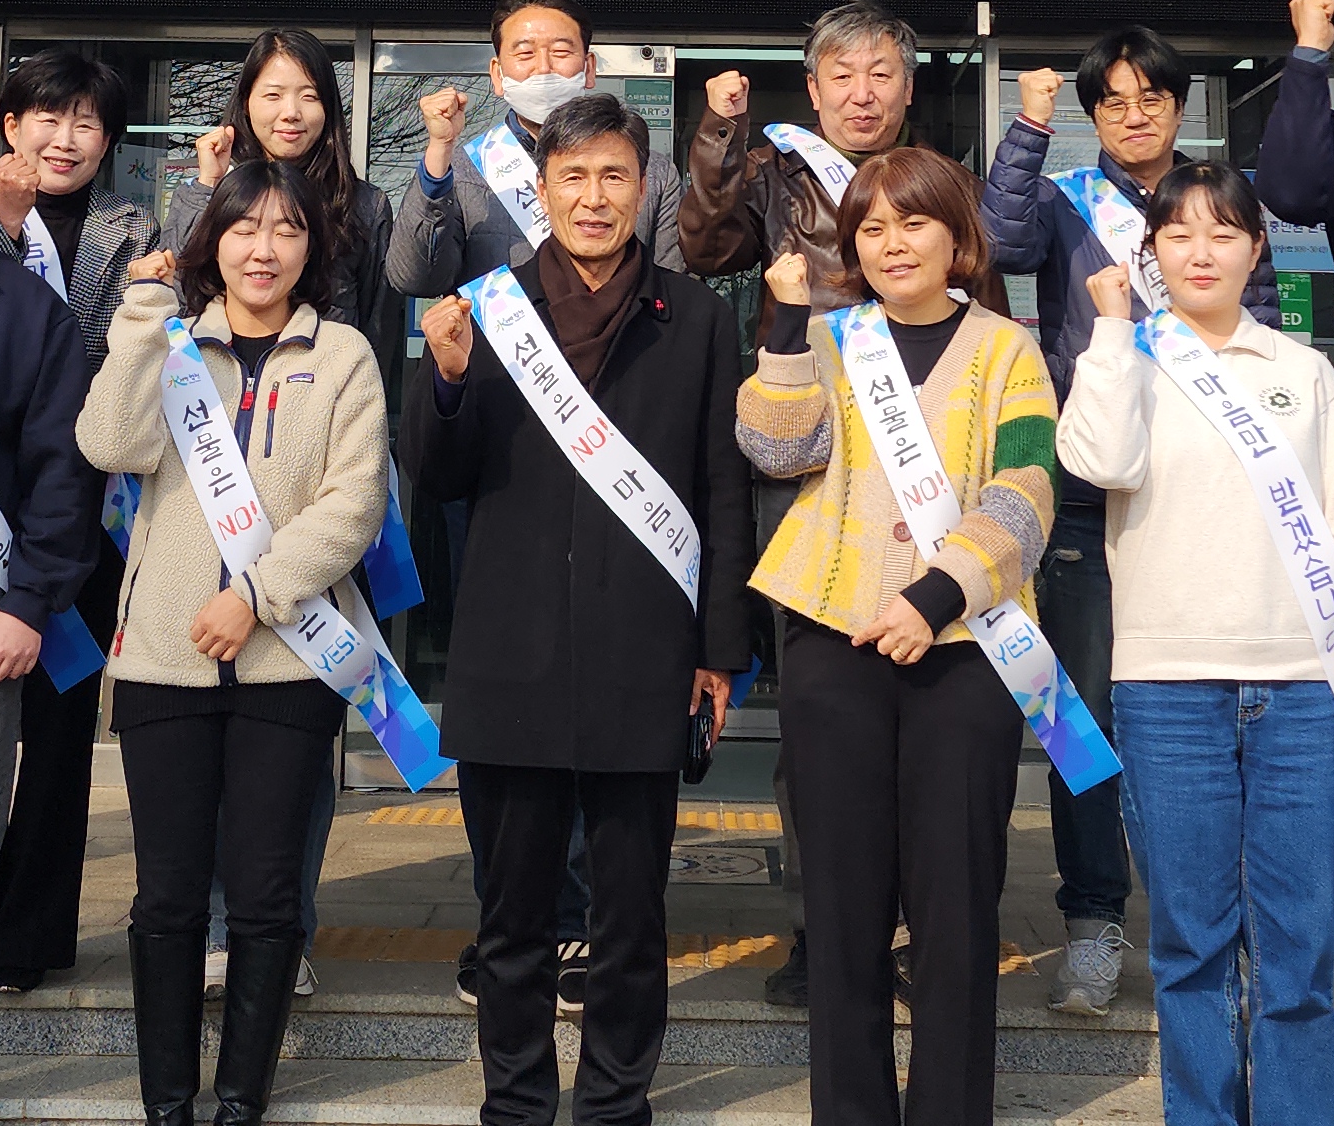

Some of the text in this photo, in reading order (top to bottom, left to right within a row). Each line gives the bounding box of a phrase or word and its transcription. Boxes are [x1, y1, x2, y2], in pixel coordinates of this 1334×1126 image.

[1280, 312, 1303, 327] ED
[514, 332, 580, 424] 선물은
[570, 417, 615, 463] NO!
[612, 469, 690, 558] 마음은
[868, 374, 921, 466] 선물은
[902, 470, 949, 513] NO!
[1192, 371, 1278, 460] 마음만
[182, 403, 238, 499] 선물은
[218, 500, 261, 541] NO!
[313, 629, 361, 675] YES!
[991, 621, 1041, 667] YES!
